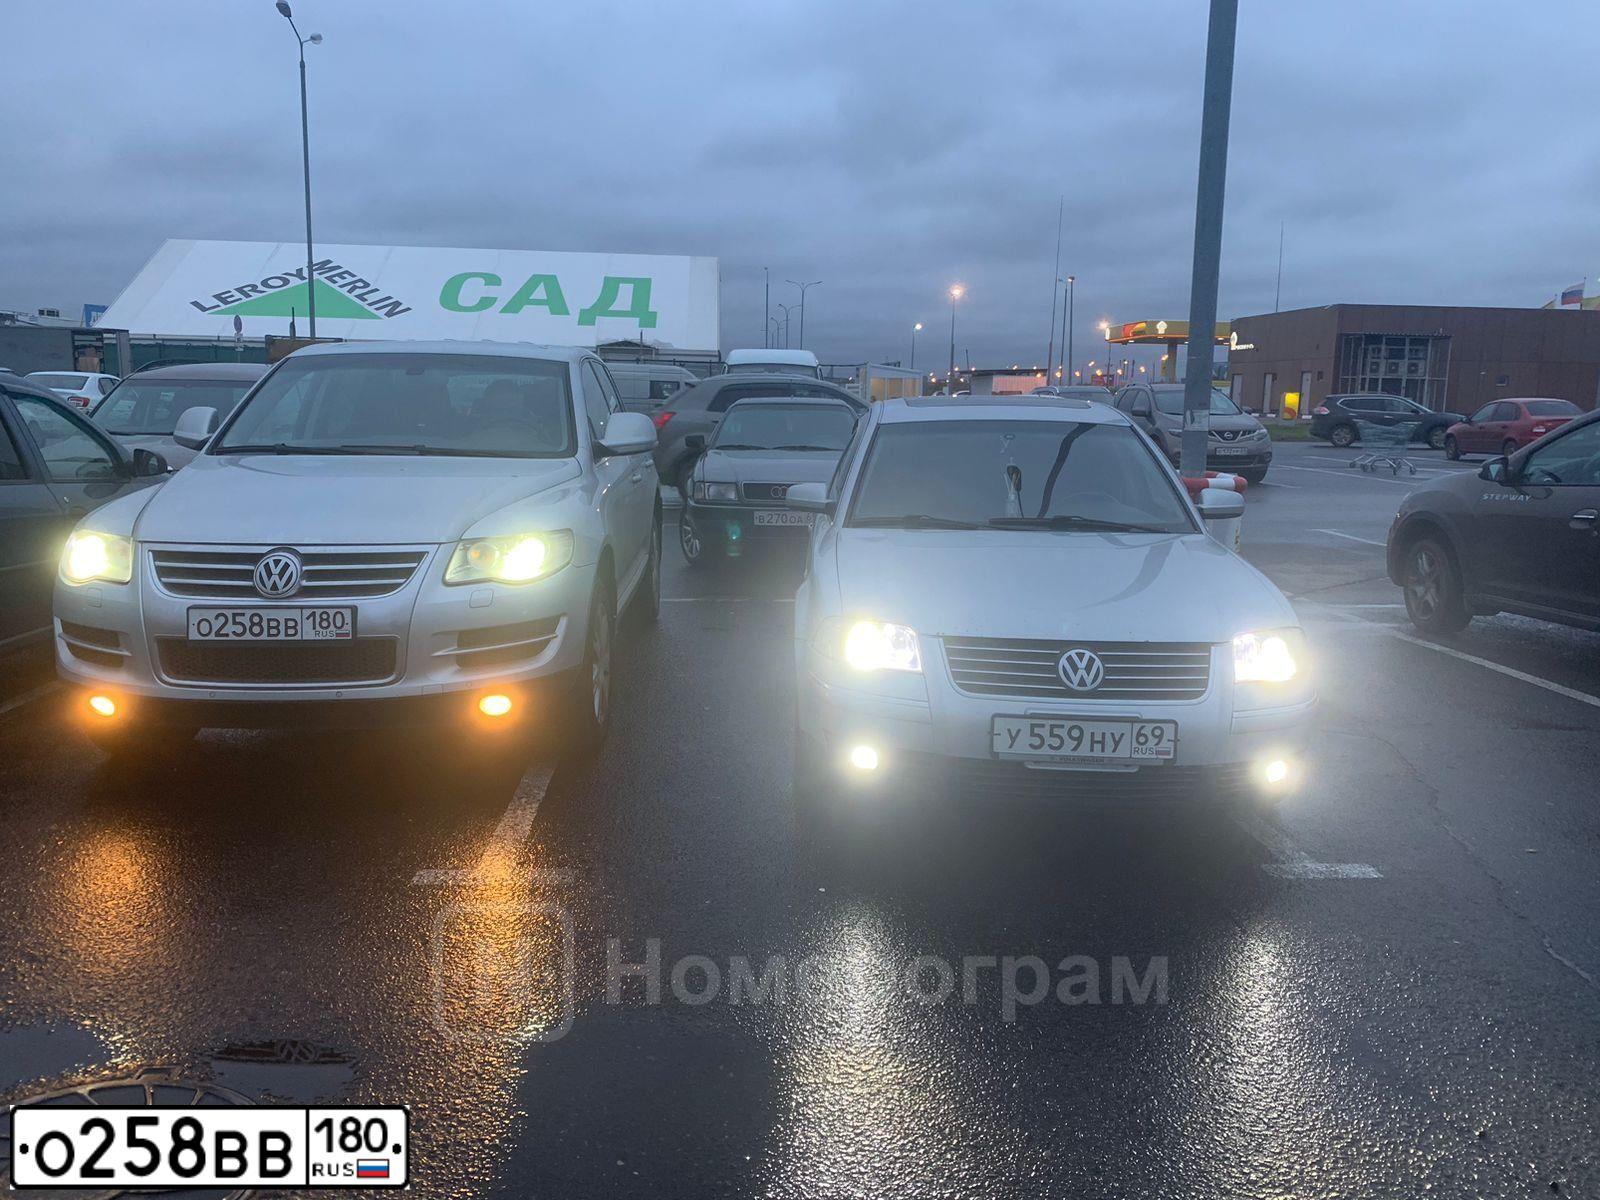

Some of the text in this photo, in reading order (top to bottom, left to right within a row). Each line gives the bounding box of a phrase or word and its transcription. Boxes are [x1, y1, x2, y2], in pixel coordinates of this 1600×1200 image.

[190, 258, 412, 319] LEROY MERLIN
[438, 271, 659, 328] САД
[196, 610, 346, 638] О258ВВ 180
[315, 630, 335, 638] RUS
[1135, 725, 1166, 747] 69
[1133, 747, 1155, 756] RUS
